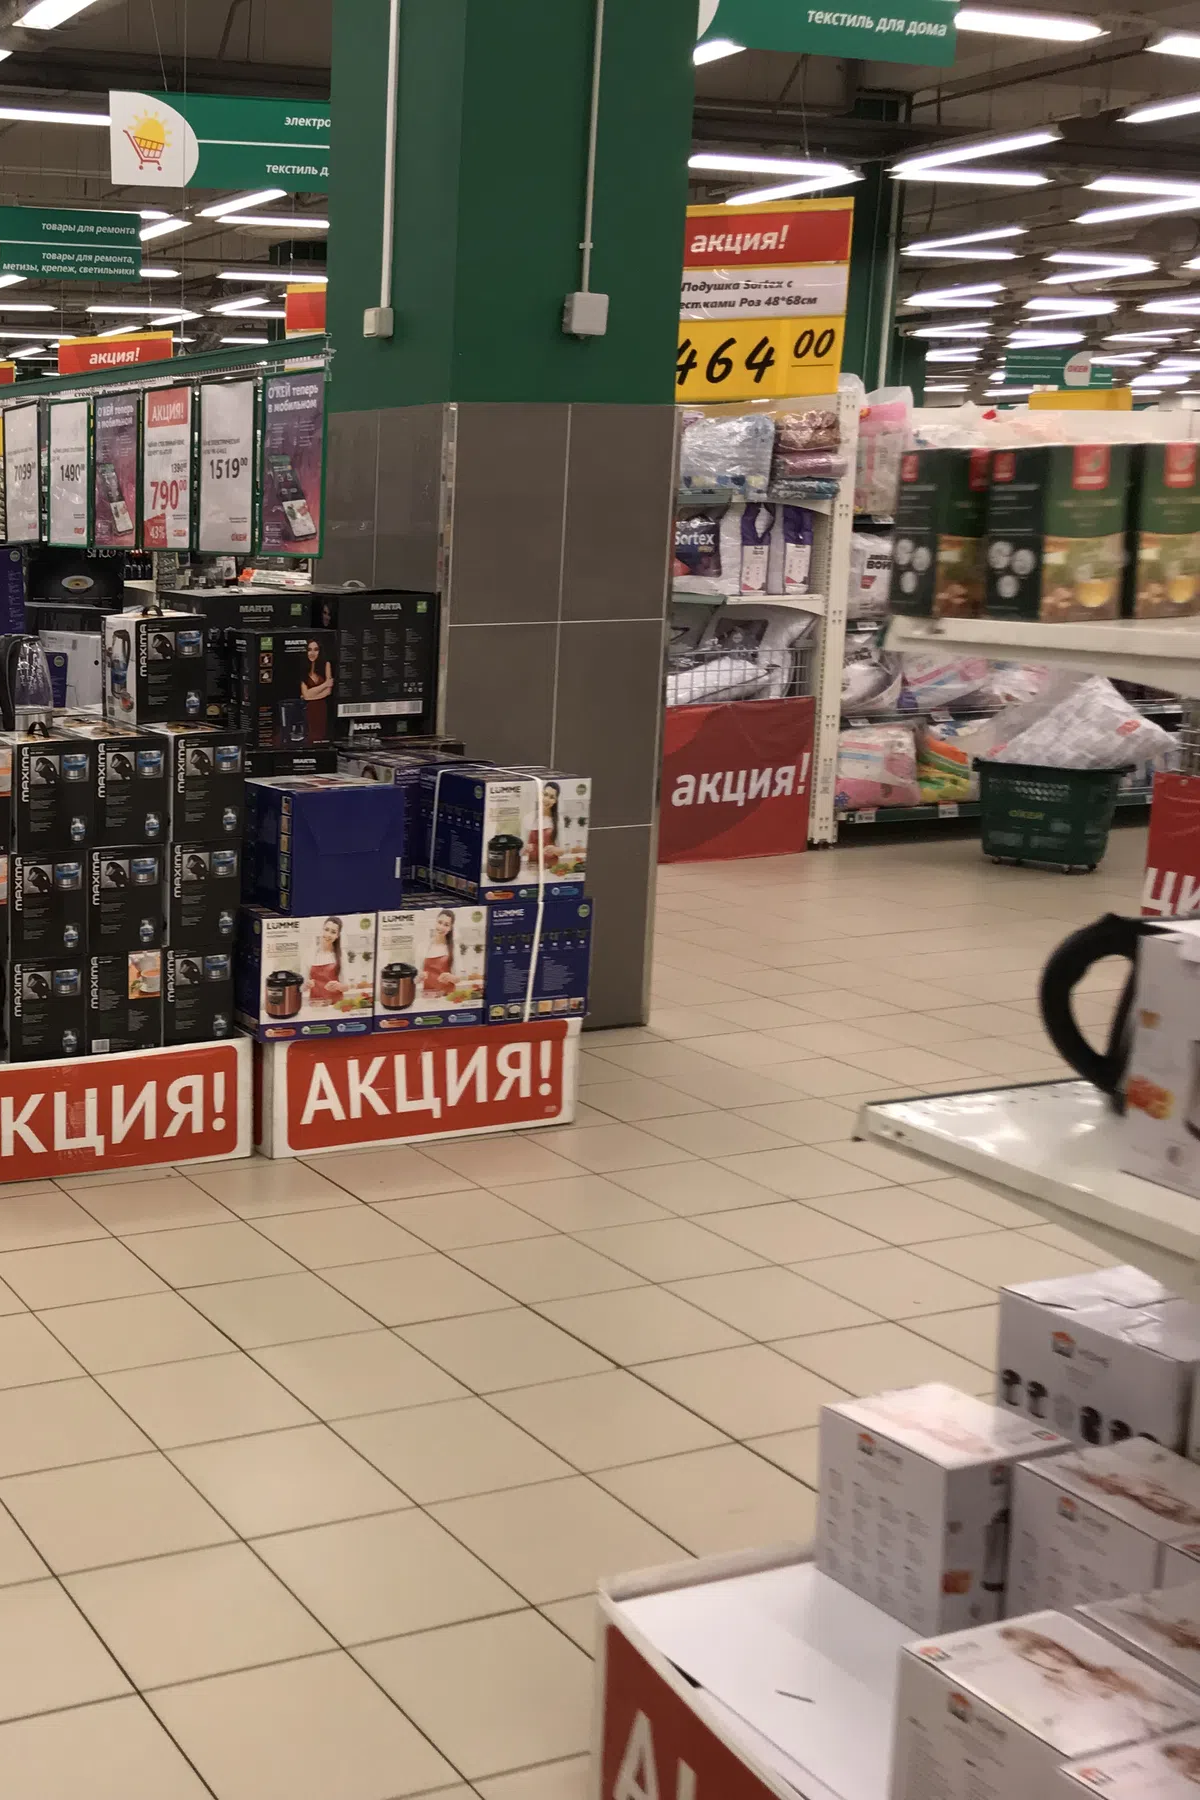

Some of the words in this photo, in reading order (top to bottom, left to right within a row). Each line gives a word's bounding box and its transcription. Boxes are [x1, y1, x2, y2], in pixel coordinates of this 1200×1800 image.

[807, 9, 874, 30] текстиль
[876, 15, 903, 34] для
[906, 19, 947, 37] дома
[265, 163, 318, 176] текстиль
[42, 222, 75, 234] товары
[77, 224, 94, 234] для
[96, 226, 136, 236] ремонта
[690, 224, 789, 255] акция!
[42, 252, 75, 263] товары
[77, 254, 94, 264] для
[96, 255, 135, 266] ремонта,
[2, 262, 40, 274] метизы,
[41, 264, 77, 276] крепеж,
[79, 265, 135, 276] светильники
[681, 281, 740, 293] Подушка
[739, 298, 762, 308] Роз
[89, 347, 140, 366] акция!
[676, 336, 775, 386] 464
[794, 329, 835, 358] 00
[292, 384, 319, 398] теперь
[151, 402, 185, 423] АКЦИЯ!
[268, 404, 273, 413] в
[274, 399, 317, 412] мобильном
[60, 464, 81, 482] 1490
[210, 457, 240, 480] 1519
[240, 457, 248, 467] 00
[150, 480, 180, 511] 790
[150, 525, 166, 539] 43%
[675, 531, 715, 546] Sortex
[239, 605, 274, 613] MARTA
[370, 603, 402, 611] MARTA
[139, 623, 147, 677] MAXIMA
[22, 747, 30, 802] MAXIMA
[98, 743, 106, 798] MAXIMA
[177, 739, 185, 794] MAXIMA
[671, 752, 811, 808] акция!
[490, 786, 521, 794] LUMME
[14, 857, 22, 912] MAXIMA
[92, 852, 100, 906] MAXIMA
[382, 914, 414, 923] LUMME
[493, 909, 525, 918] LUMME
[266, 921, 299, 930] LUMME
[90, 956, 98, 1010] MAXIMA
[167, 950, 175, 1003] MAXIMA
[14, 964, 22, 1018] MAXIMA
[300, 1040, 552, 1126] АКЦИЯ!
